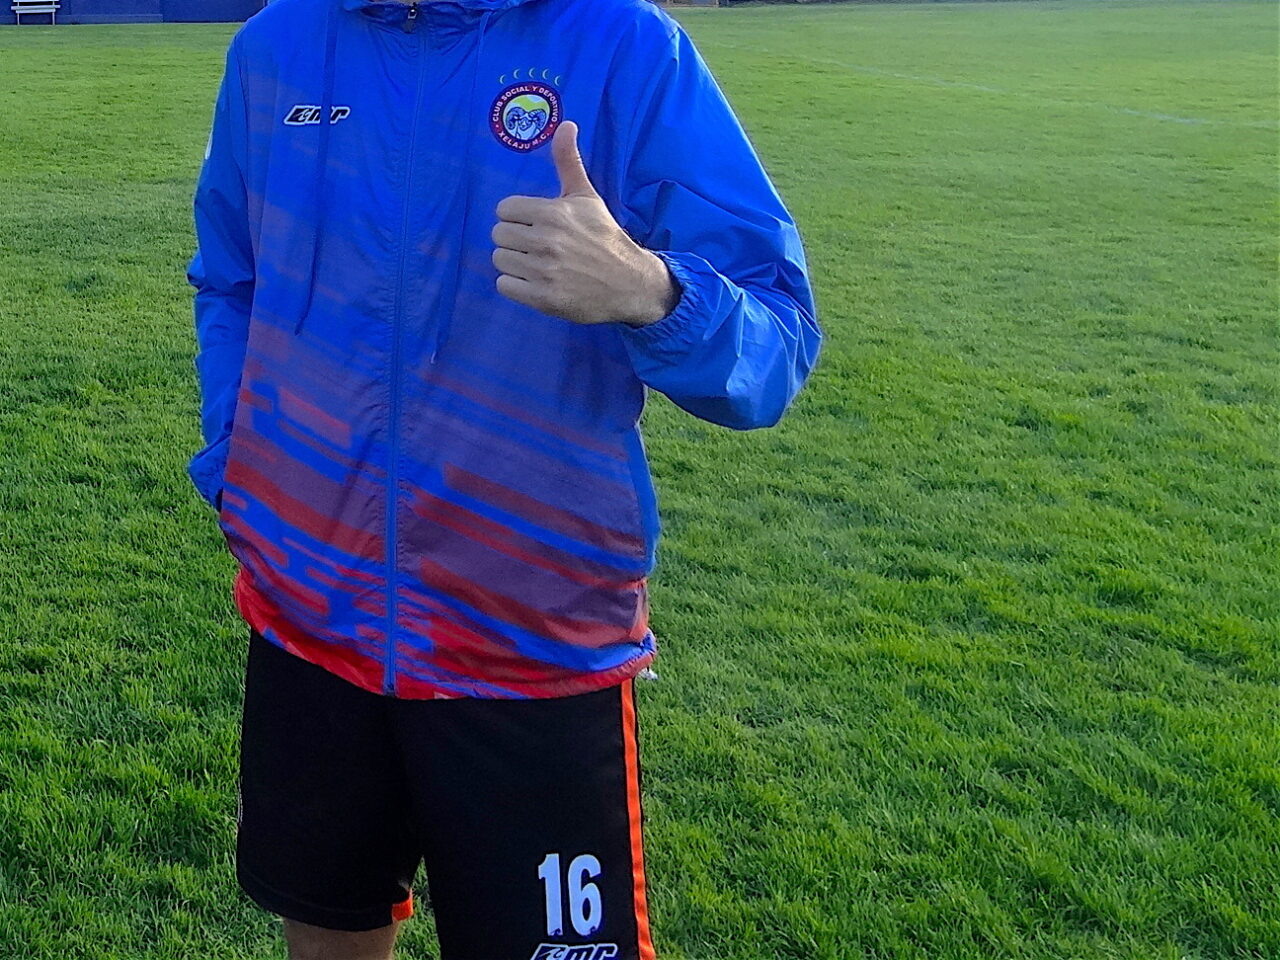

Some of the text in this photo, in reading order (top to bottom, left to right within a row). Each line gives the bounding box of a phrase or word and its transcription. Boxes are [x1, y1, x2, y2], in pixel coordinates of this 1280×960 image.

[492, 100, 504, 122] CLUB
[501, 85, 530, 102] SOCIAL
[538, 87, 559, 122] DEPORTIVO
[498, 130, 531, 150] XELAJU
[538, 853, 602, 937] 16
